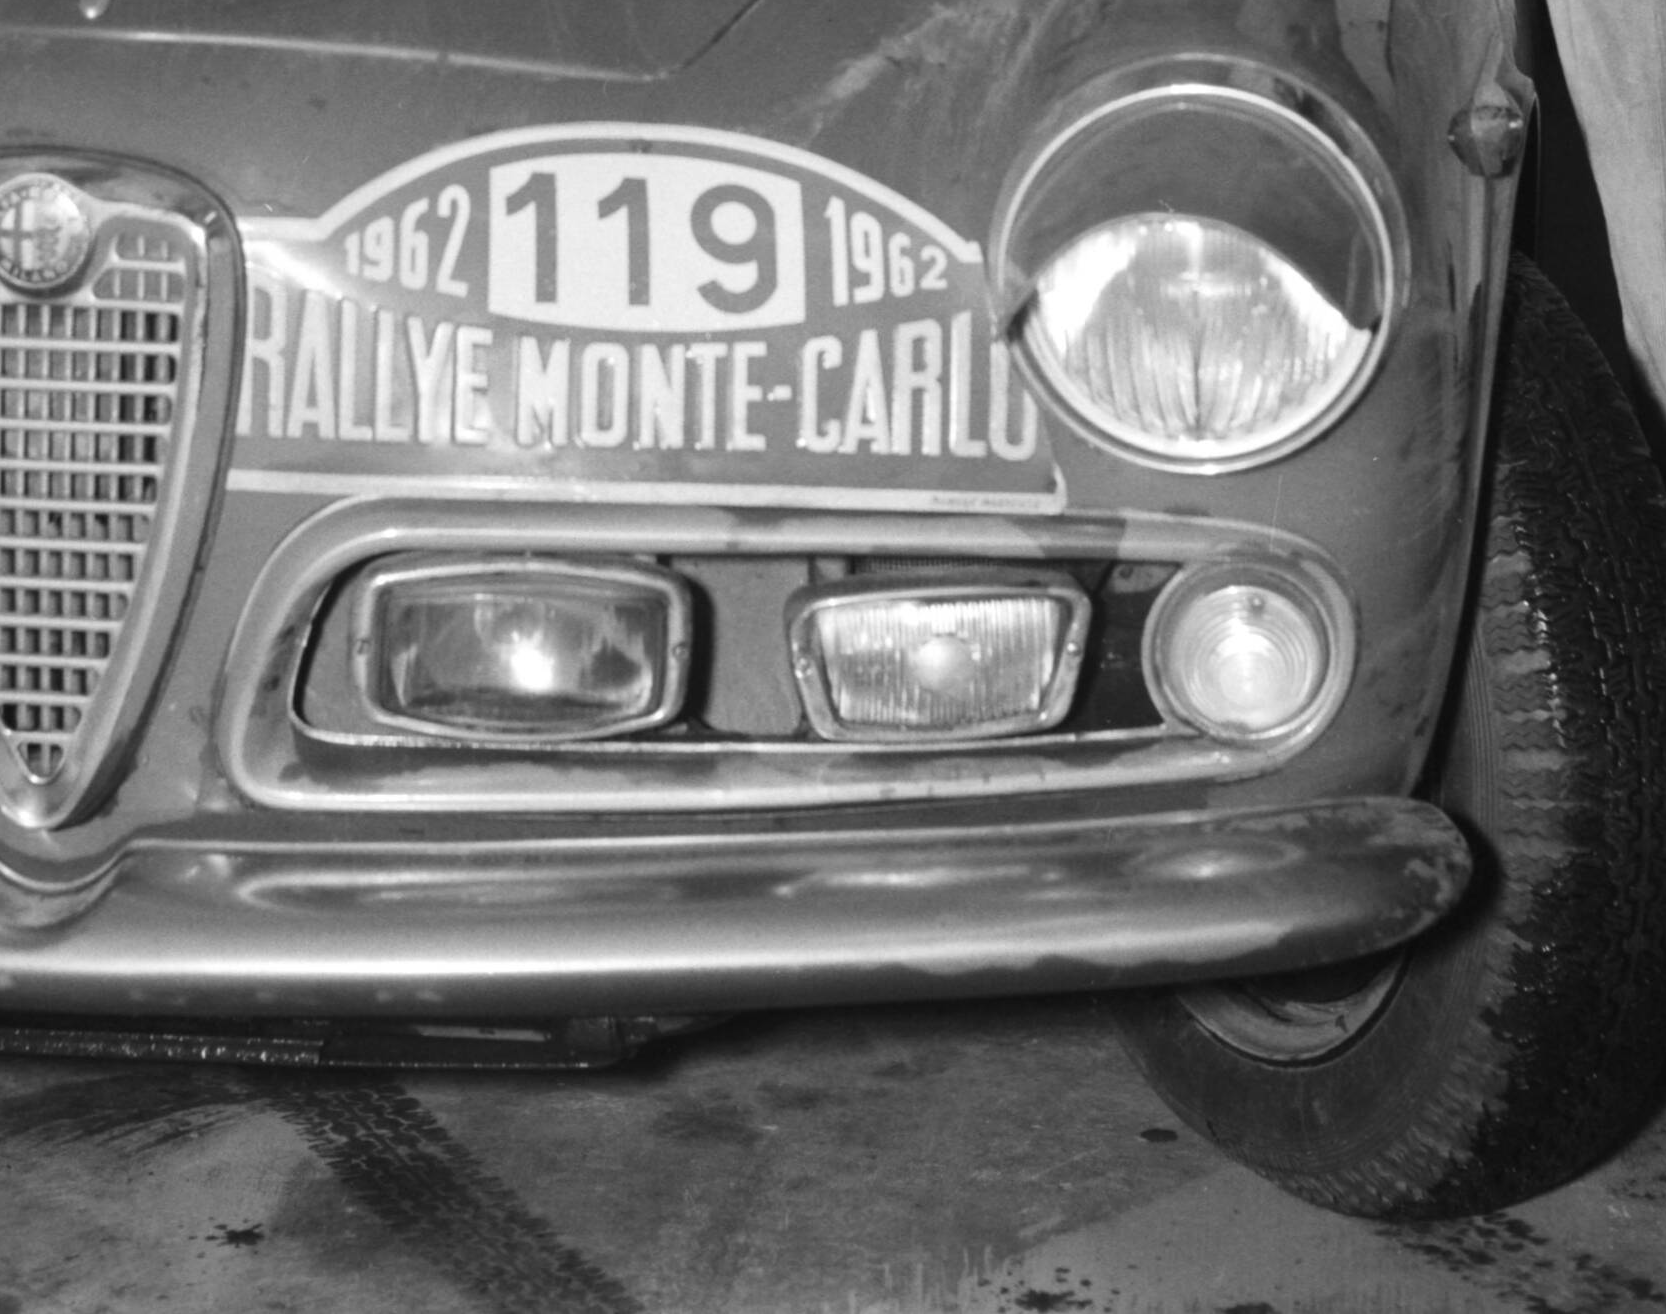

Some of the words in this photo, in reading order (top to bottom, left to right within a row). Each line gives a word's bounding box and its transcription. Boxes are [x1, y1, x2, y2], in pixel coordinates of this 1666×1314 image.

[345, 184, 471, 298] 1962
[506, 172, 779, 314] 119
[825, 195, 949, 307] 1962
[235, 272, 494, 445] RALLYE
[517, 308, 1039, 461] MONTE-CARLO
